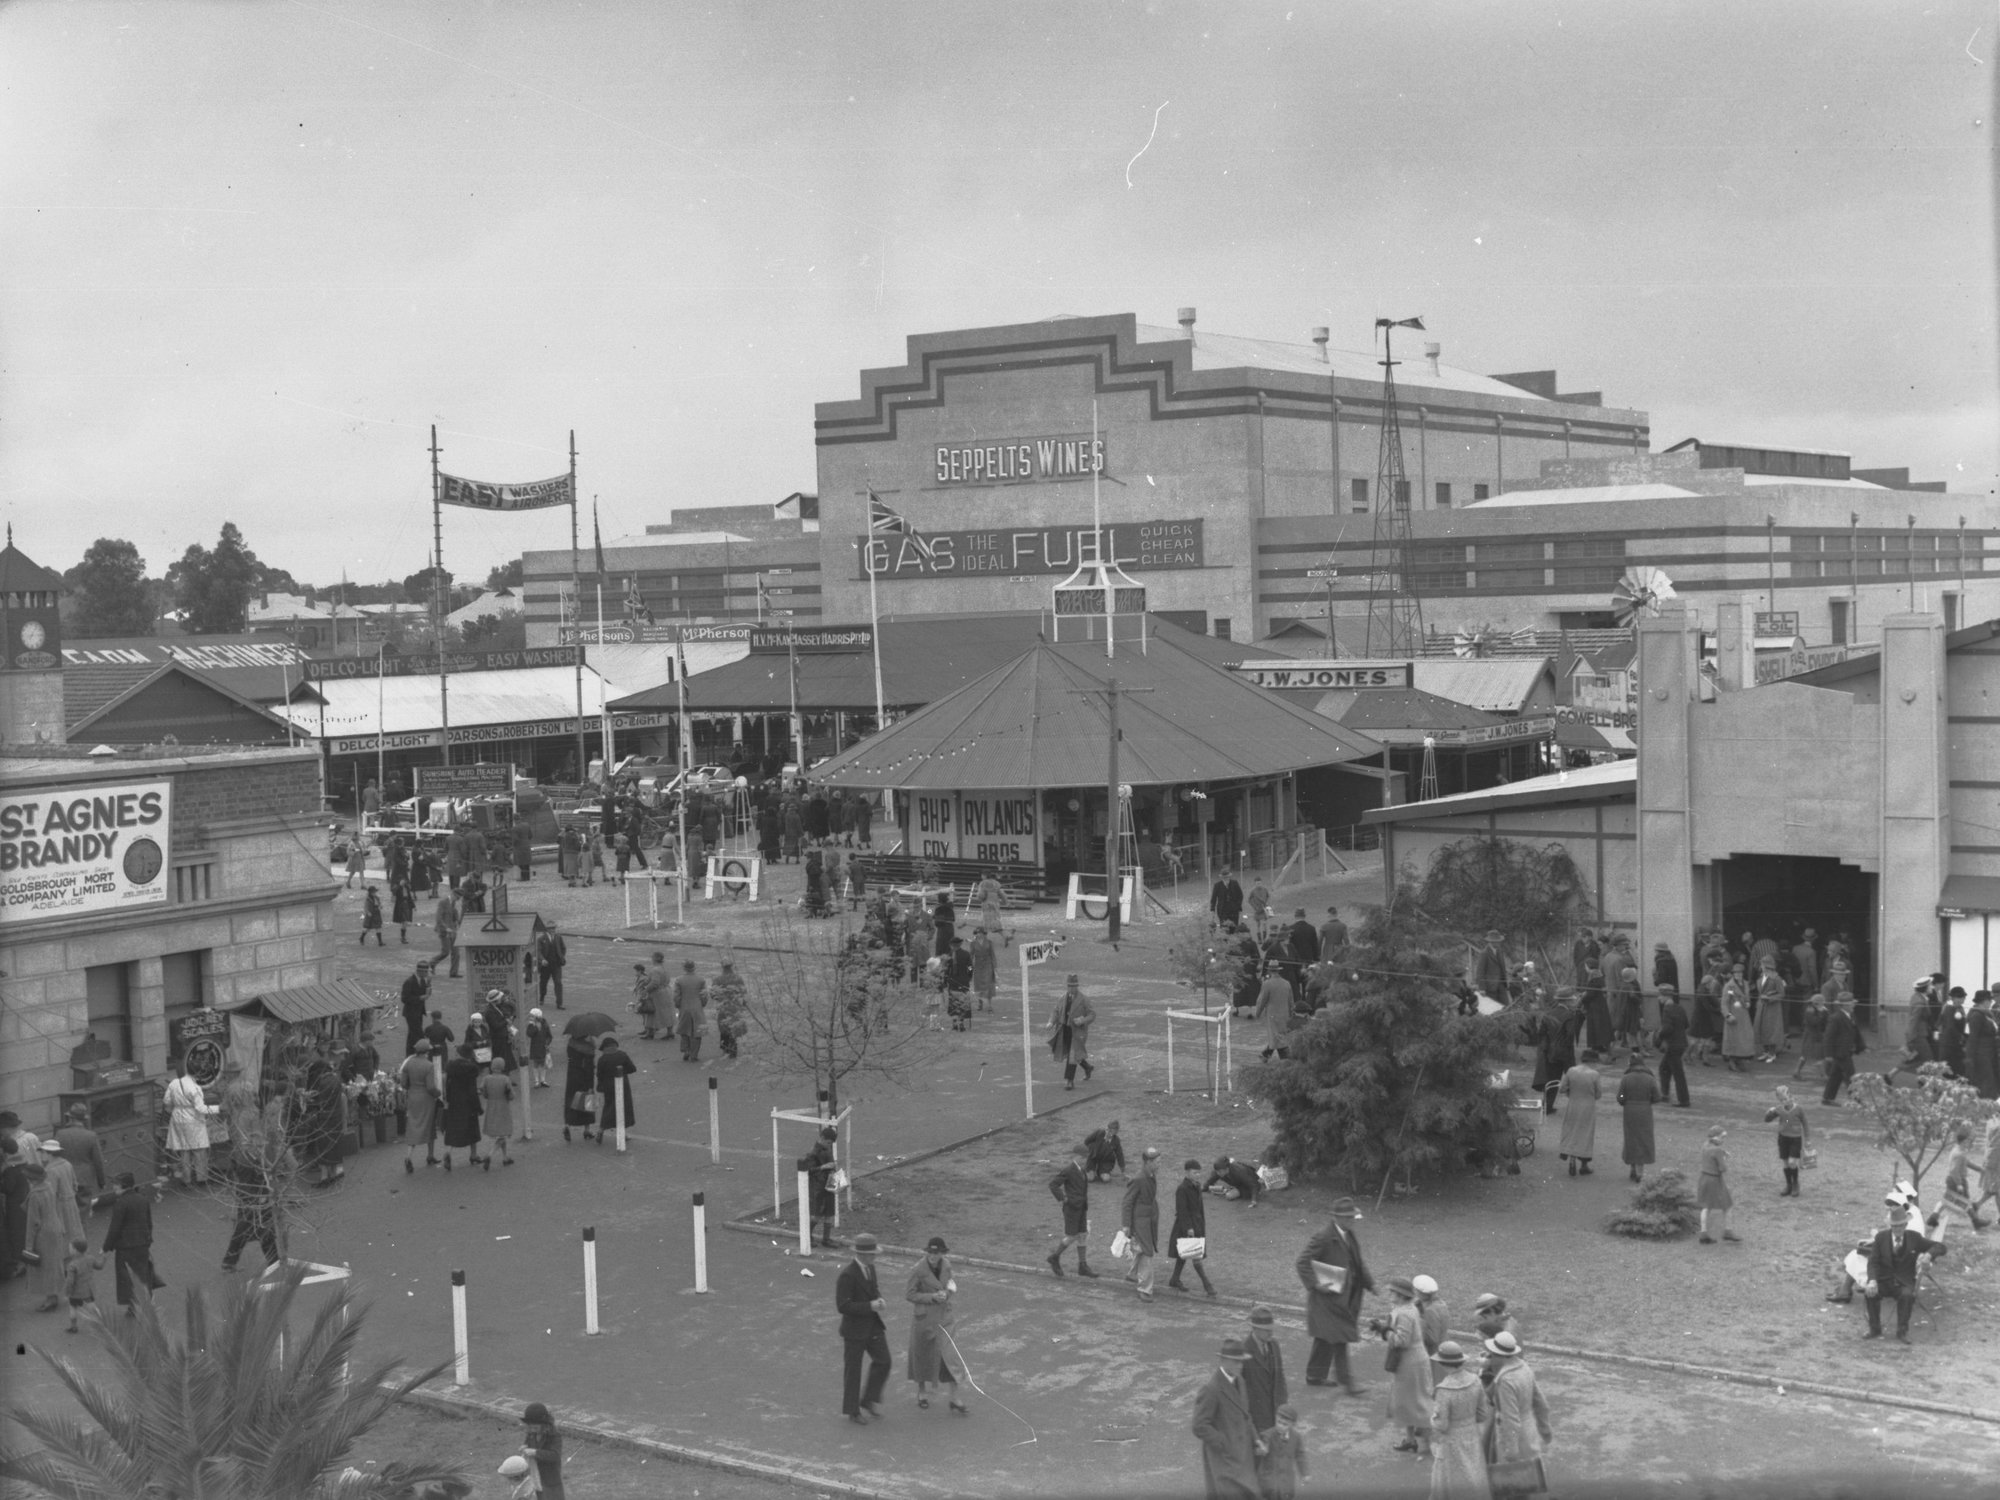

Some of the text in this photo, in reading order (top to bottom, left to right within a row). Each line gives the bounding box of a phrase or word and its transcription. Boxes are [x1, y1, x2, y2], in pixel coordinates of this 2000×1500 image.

[937, 440, 1104, 481] SEPPELTS WINES
[444, 477, 569, 508] EASY WASHERS
[520, 491, 570, 508] IRONERS
[1140, 525, 1194, 537] QUICK
[864, 529, 1138, 574] GAS THE FUEL
[1141, 539, 1195, 551] CHEAP
[962, 555, 1008, 571] IDEAL
[1141, 552, 1195, 565] CLEAN
[1756, 614, 1793, 623] ELL
[1770, 623, 1793, 631] OIL
[311, 658, 401, 677] DELCO-LIGHT
[487, 652, 521, 667] EASY
[1558, 711, 1611, 727] COWELL
[339, 734, 430, 752] DELCO-LIGHT
[447, 728, 498, 743] PARSONS
[504, 724, 560, 739] ROBERTSON
[583, 715, 663, 731] DEO-LIGHT
[422, 767, 506, 777] SUNSHINE AUTO HEADER
[42, 792, 162, 836] AGNES
[920, 797, 1033, 836] BHP RYLANDS
[0, 831, 119, 872] BRANDY
[924, 840, 1020, 862] COY BROS
[0, 872, 114, 896] GOLDSBROUGH MORT
[9, 889, 67, 905] COMPANY
[73, 883, 116, 897] LIMITED
[31, 897, 84, 911] ADELAIDE
[1026, 945, 1043, 961] MEN
